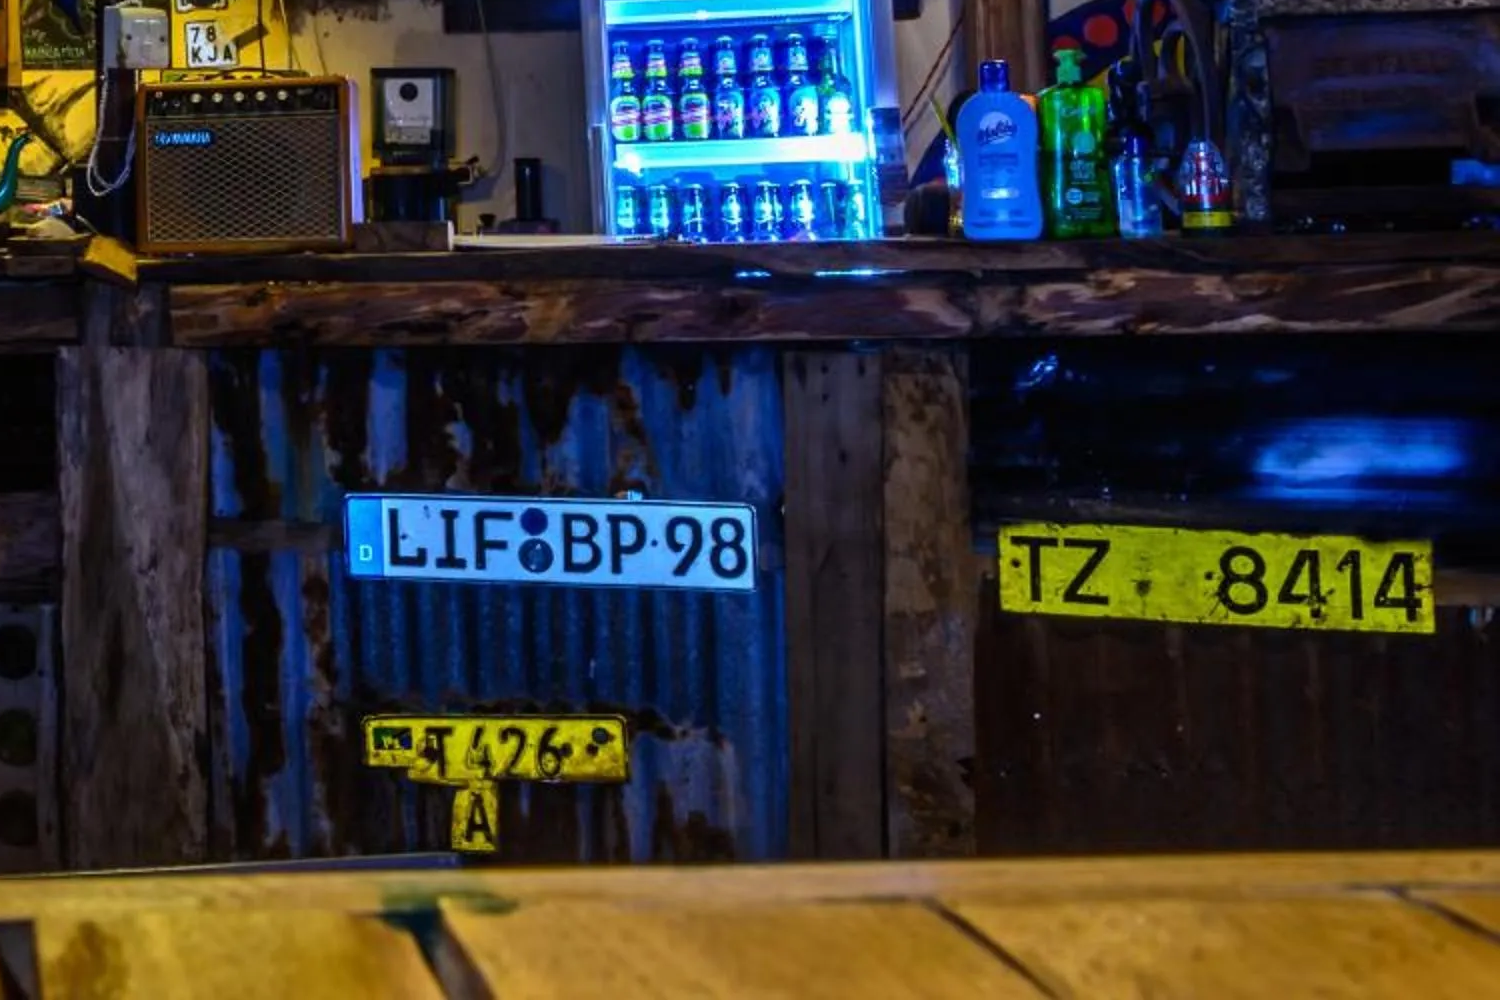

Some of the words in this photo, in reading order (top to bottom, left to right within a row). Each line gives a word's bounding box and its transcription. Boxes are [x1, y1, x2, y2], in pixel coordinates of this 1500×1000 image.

[359, 544, 373, 561] D
[388, 508, 513, 570] LIF
[1010, 535, 1111, 605] TZ
[1218, 545, 1423, 622] 8414
[465, 791, 494, 842] A
